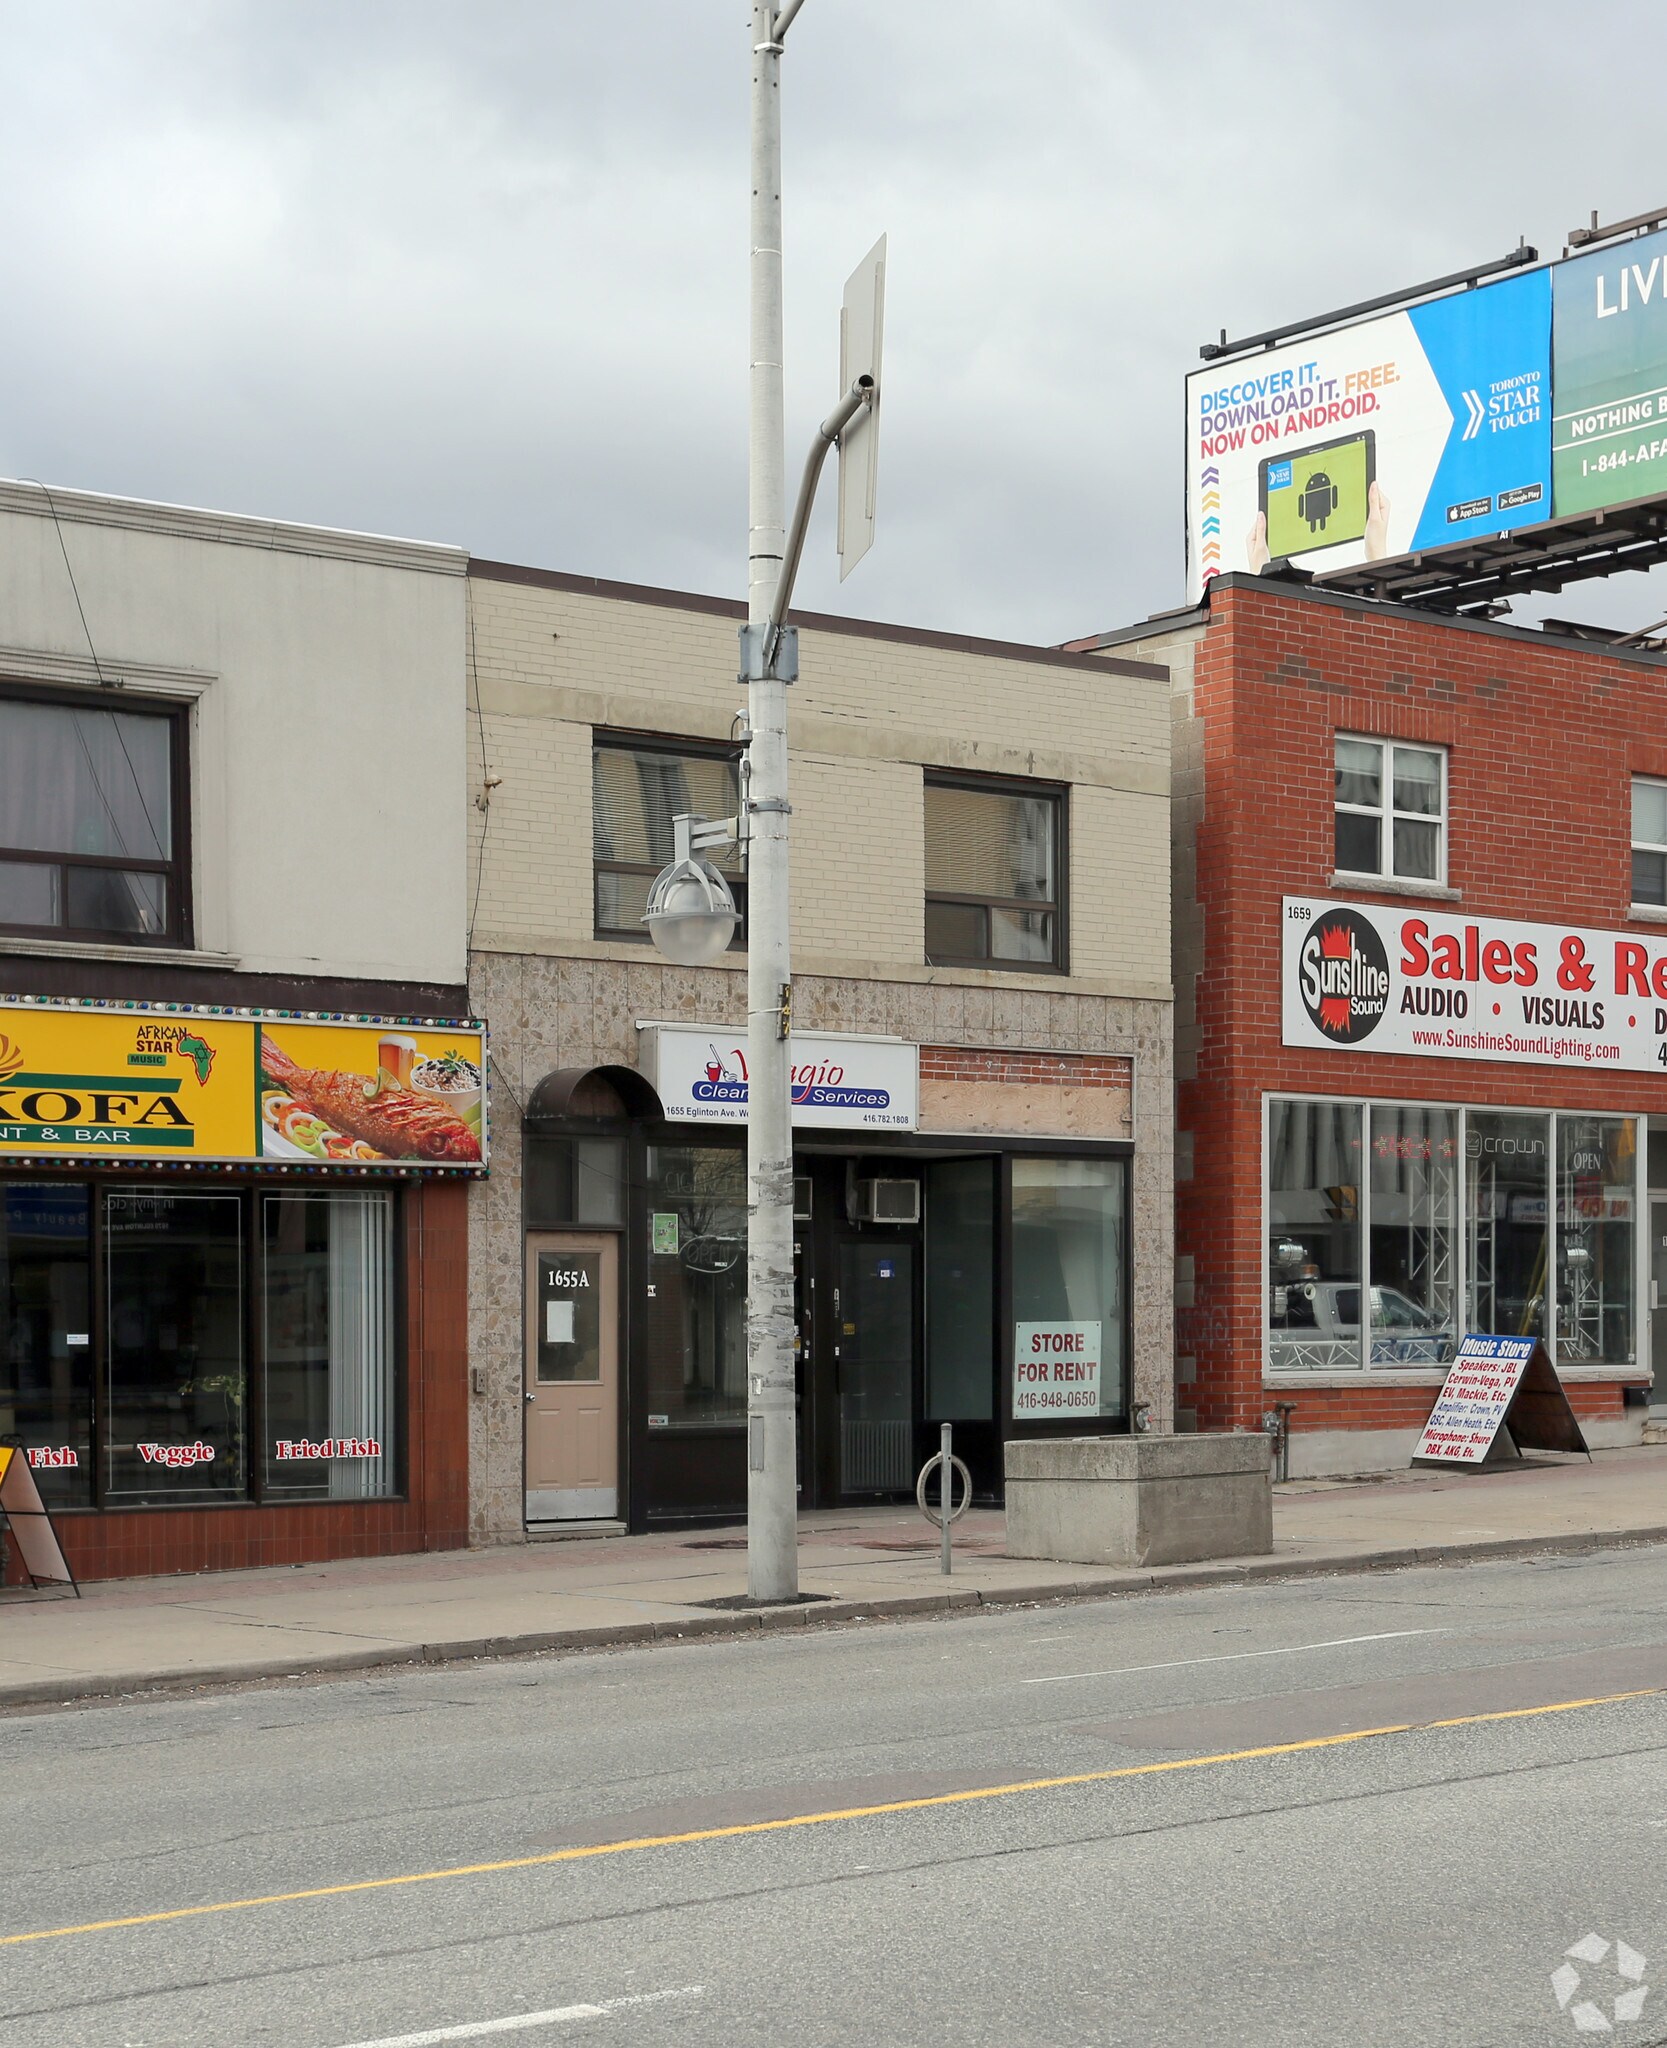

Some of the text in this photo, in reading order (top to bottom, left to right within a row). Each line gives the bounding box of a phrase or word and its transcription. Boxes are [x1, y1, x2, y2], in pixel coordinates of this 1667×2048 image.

[1200, 361, 1321, 415] DISCOVER IT.
[1489, 370, 1541, 394] TORONTO
[1200, 362, 1401, 437] DOWNLOAD IT. FREE.
[1488, 384, 1541, 417] STAR
[1200, 391, 1381, 460] NOW ON ANDROID.
[1489, 405, 1541, 433] TOUCH
[1571, 400, 1653, 438] NOTHING
[1508, 494, 1527, 505] Google
[1527, 491, 1540, 500] Play
[1460, 505, 1489, 519] App Store
[1288, 906, 1311, 920] 1659
[1400, 918, 1539, 988] Sales
[1556, 935, 1596, 993] &
[1302, 932, 1389, 1010] Sunshine
[1351, 996, 1384, 1015] Sound
[1400, 985, 1468, 1019] AUDIO
[1522, 995, 1605, 1030] VISUALS
[137, 1025, 187, 1041] AFRICAN
[136, 1040, 173, 1053] STAR
[1412, 1028, 1620, 1062] www.SunshineSoundLighting.com
[130, 1054, 163, 1064] MUSIC
[812, 1089, 888, 1106] Services
[666, 1106, 685, 1116] 1655
[686, 1107, 719, 1119] Eglinton
[720, 1108, 738, 1118] Ave.
[862, 1114, 909, 1125] 416.782.1808
[41, 1127, 60, 1141] &
[75, 1129, 131, 1142] BAR
[1484, 1136, 1545, 1155] crown
[1574, 1152, 1601, 1170] OPEN
[548, 1269, 590, 1288] 1655A
[1031, 1333, 1084, 1353] STORE
[1460, 1338, 1532, 1358] Music Store
[1018, 1362, 1097, 1382] FOR RENT
[1458, 1360, 1518, 1373] Speakers: JBL
[1447, 1373, 1518, 1389] Cerwin-Vega, PV
[1017, 1391, 1096, 1408] 416-948-0650
[1442, 1387, 1508, 1402] EV, Mackie, Etc.
[1437, 1401, 1504, 1416] Amplifier: Crown, PV
[1483, 1418, 1496, 1430] Etc.
[1423, 1429, 1490, 1444] Microphone: Shure
[28, 1446, 78, 1468] Fish
[138, 1441, 215, 1468] Veggie
[276, 1437, 381, 1460] Fried Fish
[1425, 1443, 1475, 1458] DBX, AKG, Etc.
